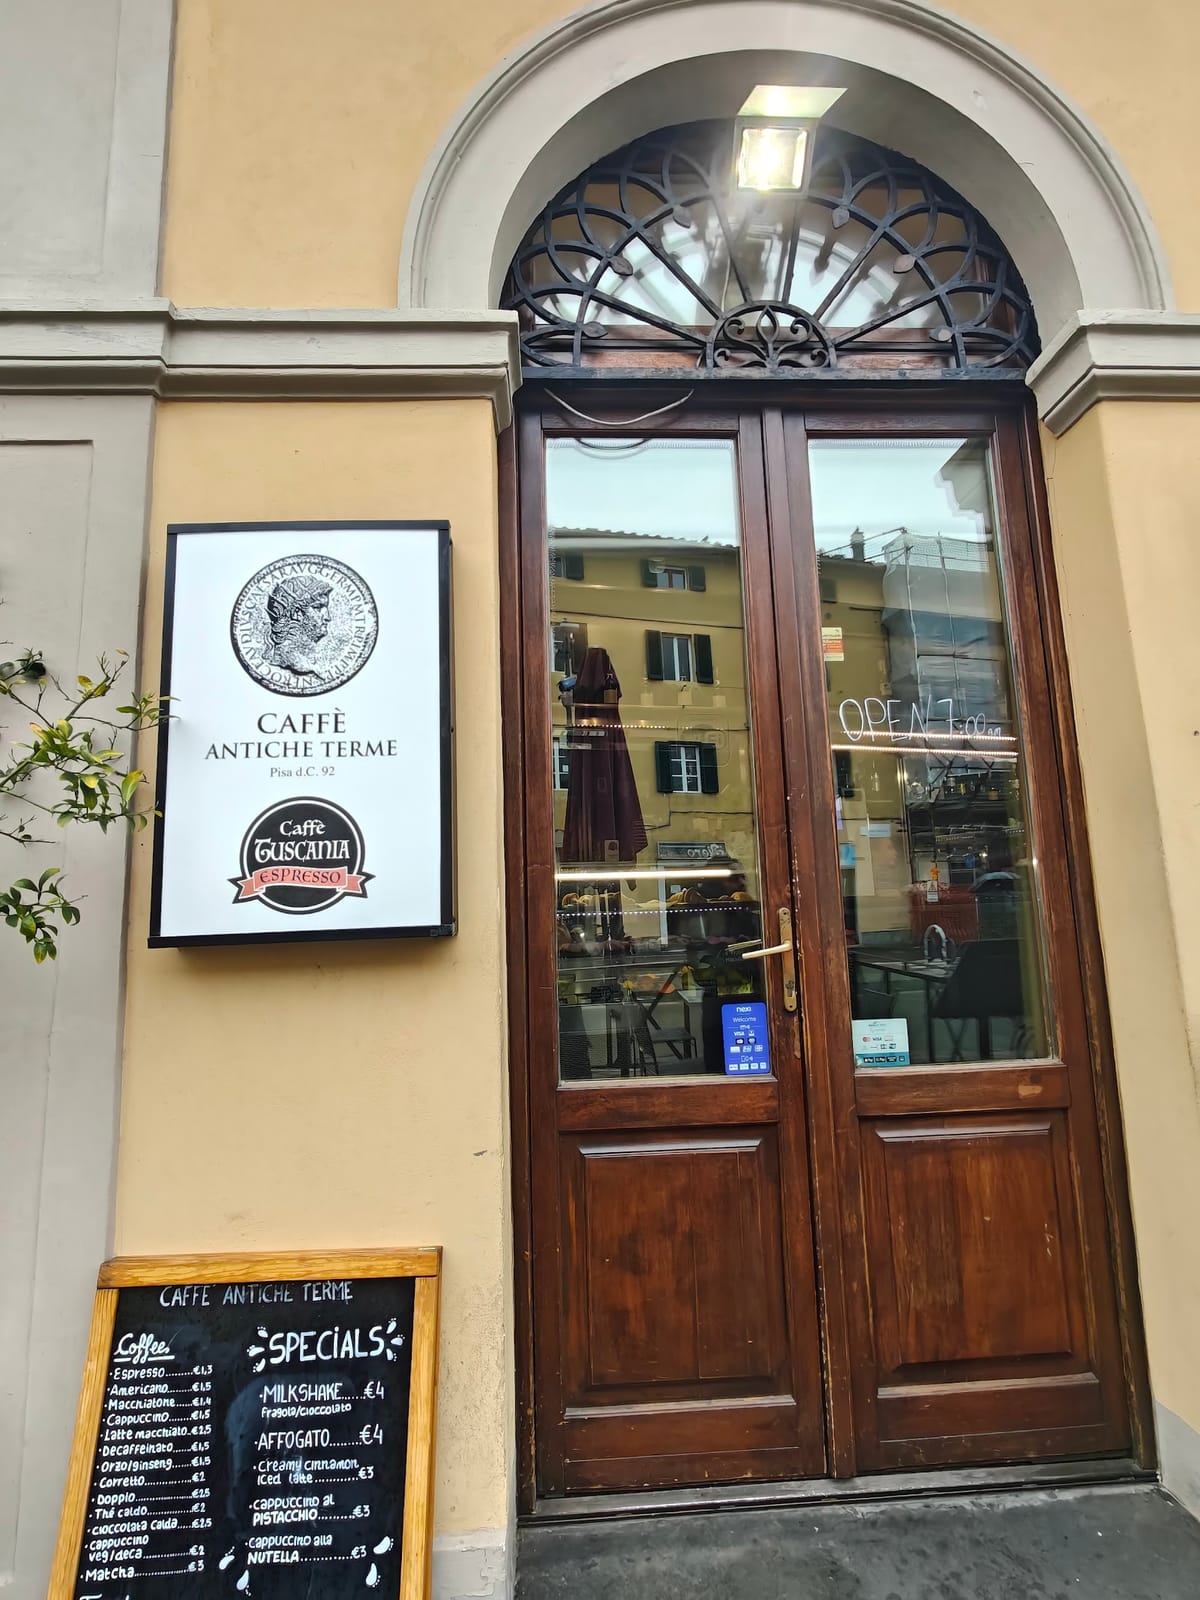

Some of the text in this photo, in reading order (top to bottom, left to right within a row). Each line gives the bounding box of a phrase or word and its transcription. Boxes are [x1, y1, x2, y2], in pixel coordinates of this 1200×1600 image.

[257, 707, 346, 734] CAFFÈ
[839, 694, 932, 742] OPEN
[205, 739, 398, 760] ANTICHE TERME
[270, 766, 335, 777] Pisa d.C. 92
[279, 819, 326, 837] Caffè
[259, 868, 342, 884] ESPRESSO
[222, 1283, 294, 1306] ANTICHE
[303, 1281, 353, 1304] TERME
[113, 1333, 170, 1364] Coffee
[113, 1367, 165, 1380] Espresso
[110, 1383, 169, 1396] Americano
[263, 1380, 385, 1404] MILKSHAKE €4
[108, 1397, 176, 1411] Macchiatone
[106, 1411, 169, 1426] Cappuccino
[104, 1428, 133, 1441] Latte
[135, 1426, 188, 1439] macchiato
[257, 1424, 383, 1451] AFFOGATO €4
[102, 1442, 173, 1457] Decaffeinato
[101, 1458, 173, 1473] Orzo/ginseng
[358, 1466, 374, 1480] €3
[191, 1471, 206, 1483] €2
[97, 1491, 135, 1506] Doppio
[322, 1494, 335, 1507] al
[191, 1502, 206, 1513] €2
[253, 1505, 371, 1527] PISTACCHIO €3
[313, 1534, 333, 1547] alla
[89, 1545, 206, 1563] veg/deca €2
[247, 1546, 367, 1565] NUTELLA €3
[85, 1566, 135, 1582] Matcha
